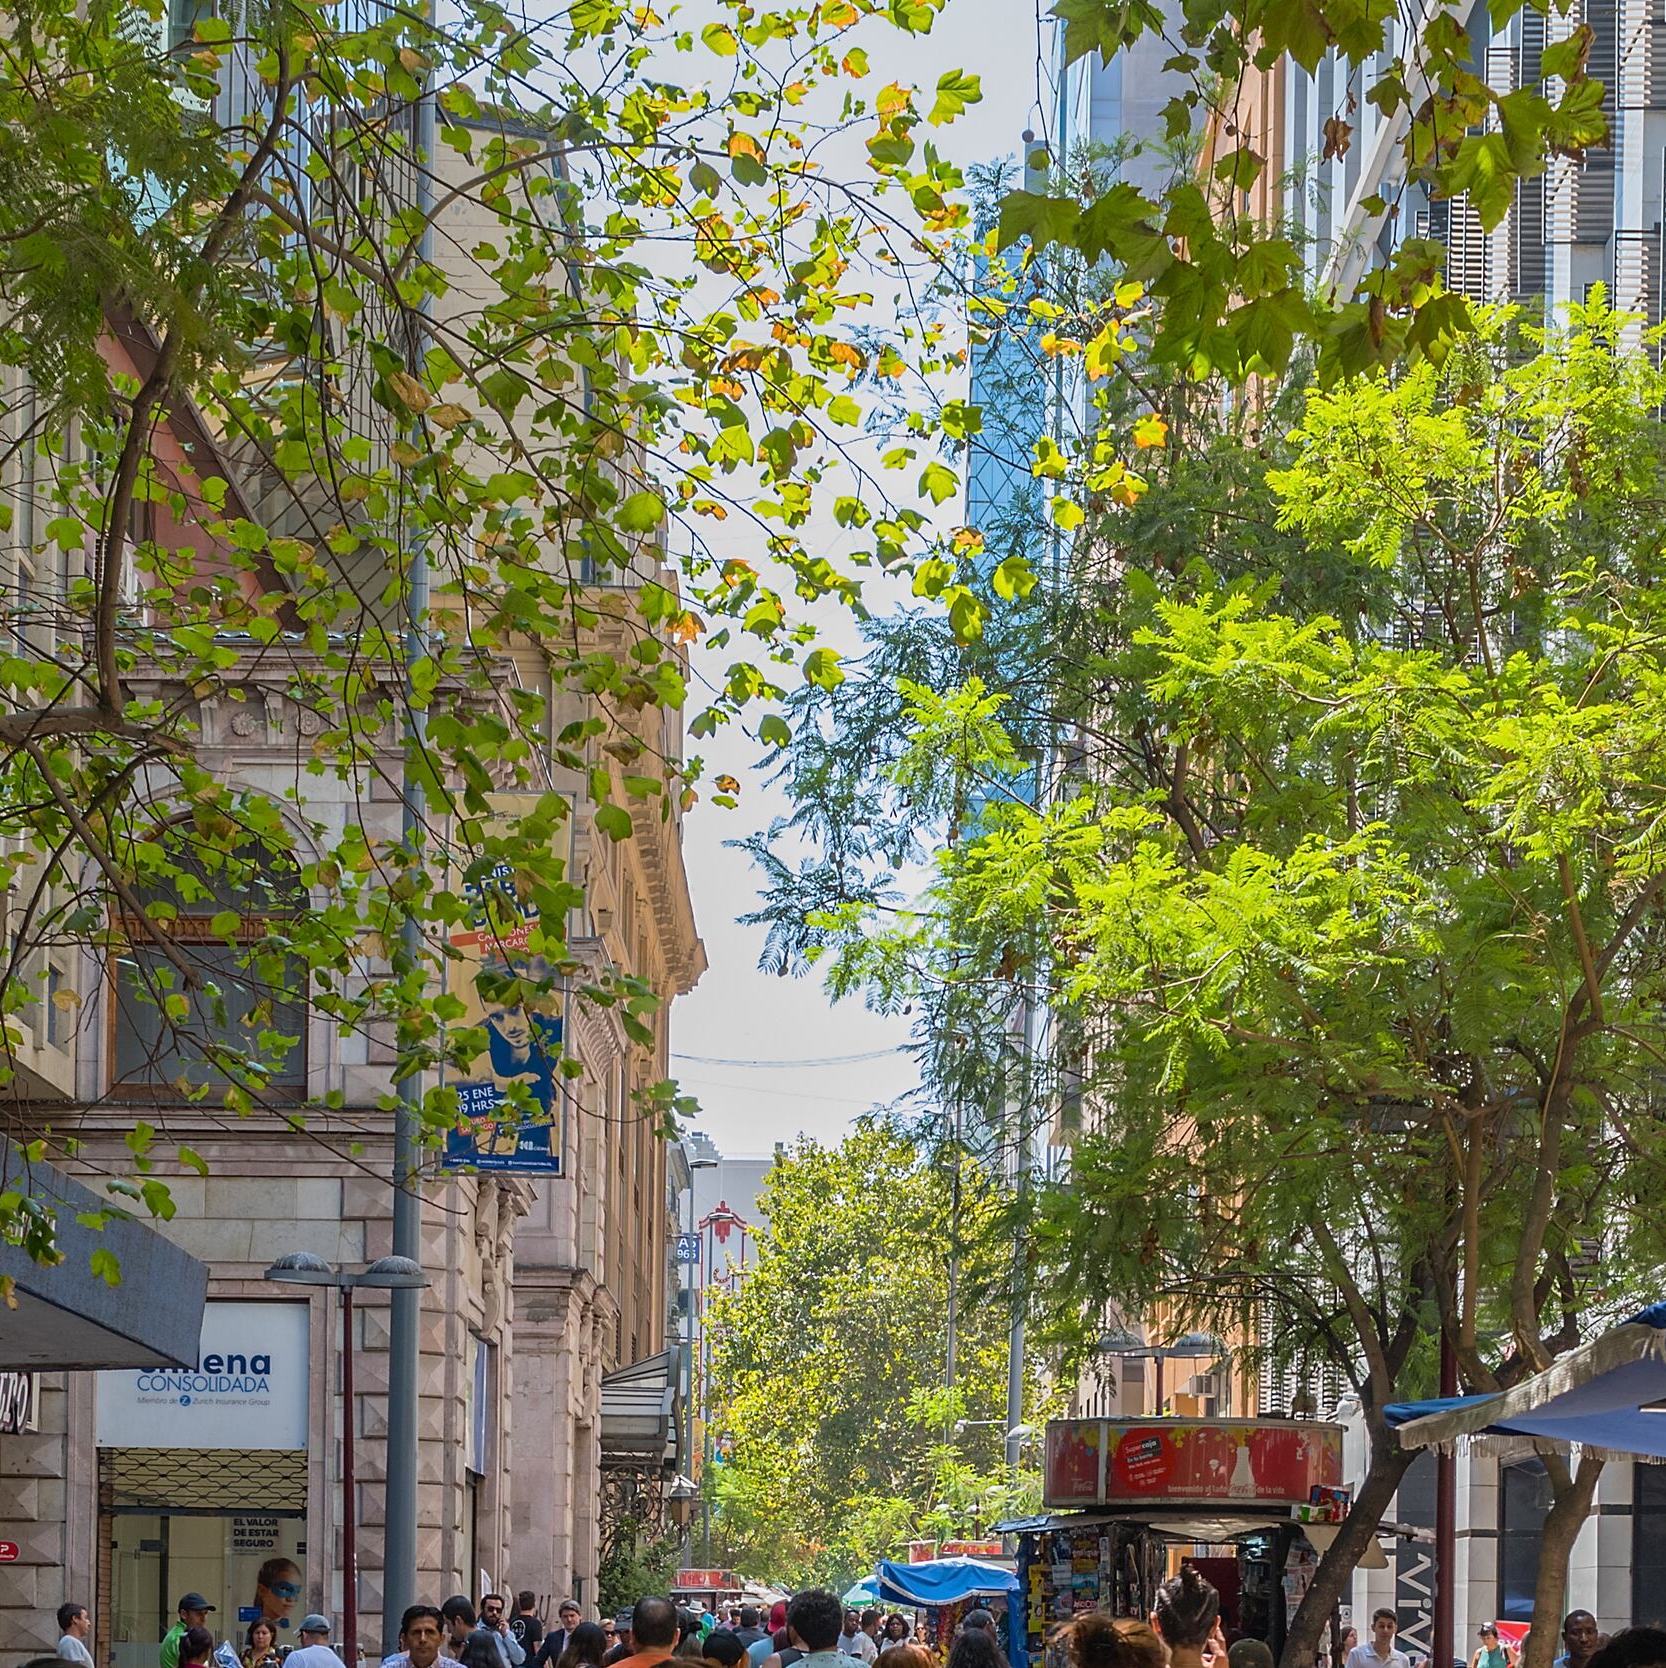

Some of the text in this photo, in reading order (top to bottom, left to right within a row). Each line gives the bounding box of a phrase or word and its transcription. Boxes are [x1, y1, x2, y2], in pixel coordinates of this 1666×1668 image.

[473, 1087, 493, 1100] ENE
[472, 1099, 495, 1112] HRS
[137, 1375, 270, 1393] CONSOLIDADA
[234, 1518, 278, 1527] EL VALOR
[233, 1528, 279, 1537] DE ESTAR
[233, 1539, 274, 1548] SEGURO
